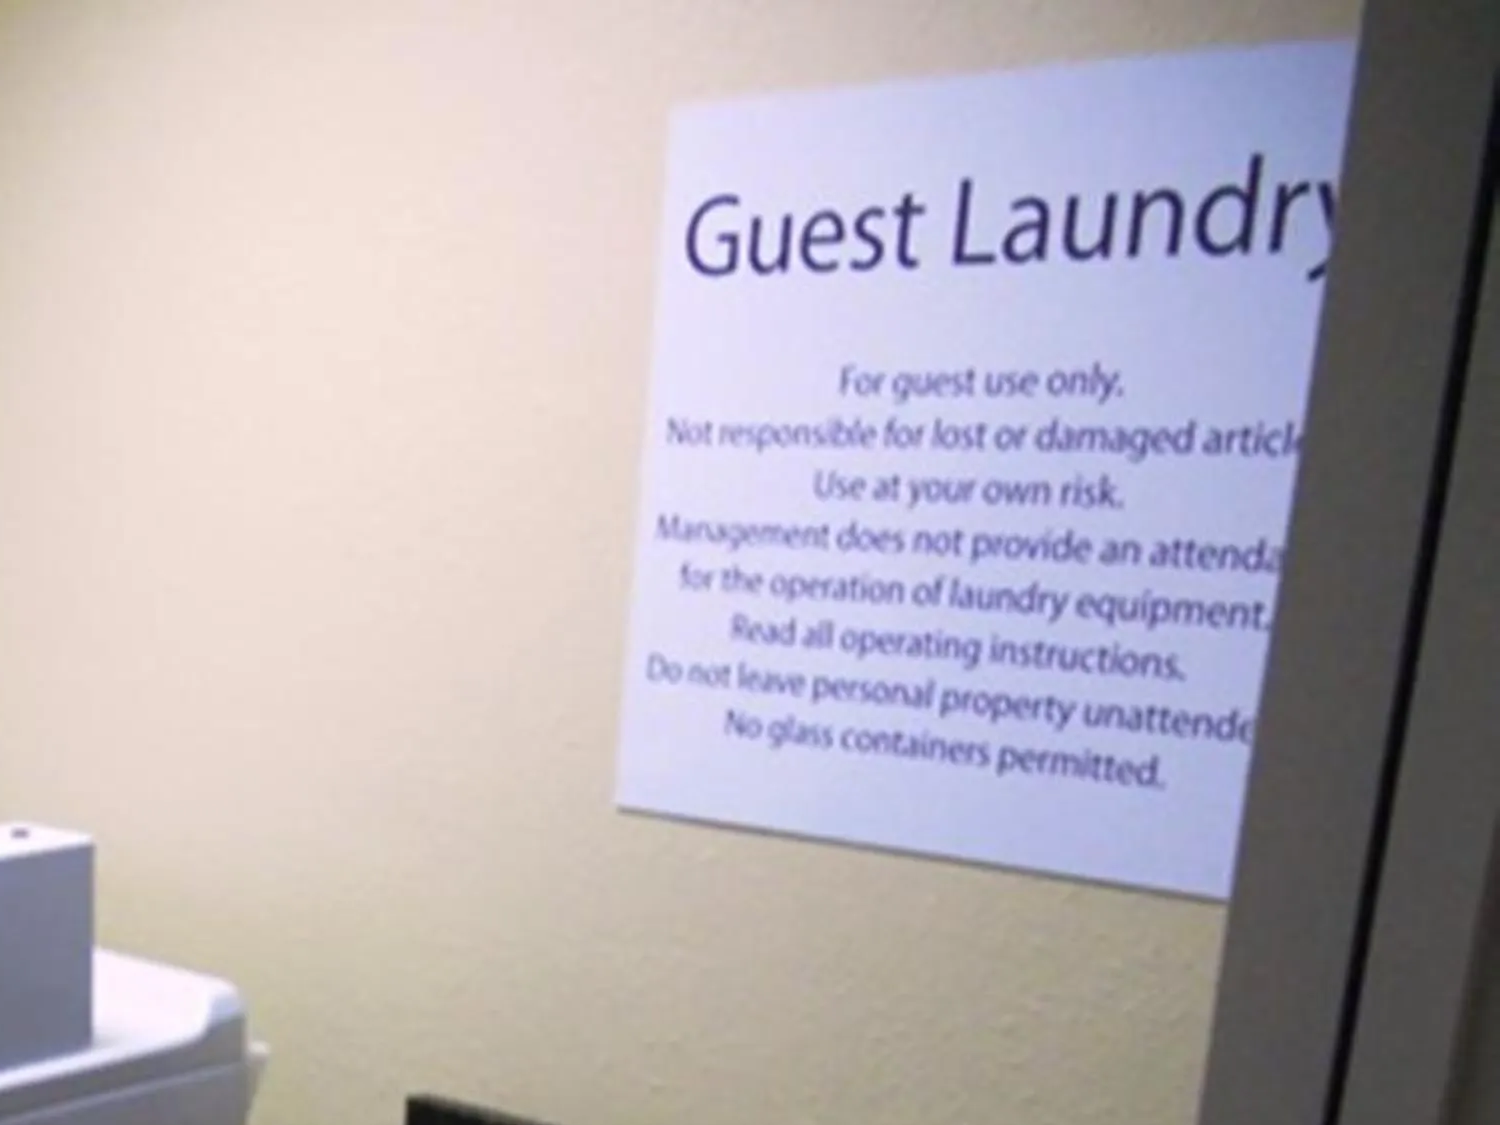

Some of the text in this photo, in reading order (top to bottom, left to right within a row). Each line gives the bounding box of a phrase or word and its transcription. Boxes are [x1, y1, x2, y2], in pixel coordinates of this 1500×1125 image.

[684, 193, 925, 278] Guest
[838, 361, 1124, 405] For guest use only.
[666, 417, 713, 445] Not
[719, 417, 878, 453] responsible
[883, 417, 925, 448] for
[931, 417, 987, 450] lost
[994, 423, 1027, 452] or
[1033, 417, 1198, 463] damaged
[813, 468, 1124, 511] Use at your own risk.
[656, 513, 830, 552] Management
[836, 520, 905, 553] does
[912, 528, 964, 556] not
[970, 529, 1092, 566] provide
[1099, 538, 1142, 567] an
[680, 560, 1271, 632] for the operation of laundry equipment.
[730, 612, 1187, 683] Read all operating instructions.
[646, 652, 682, 684] Do
[687, 661, 730, 688] not
[737, 661, 806, 699] leave
[811, 673, 936, 709] personal
[938, 687, 1076, 732] property
[724, 708, 1167, 791] No glass containers permitted.
